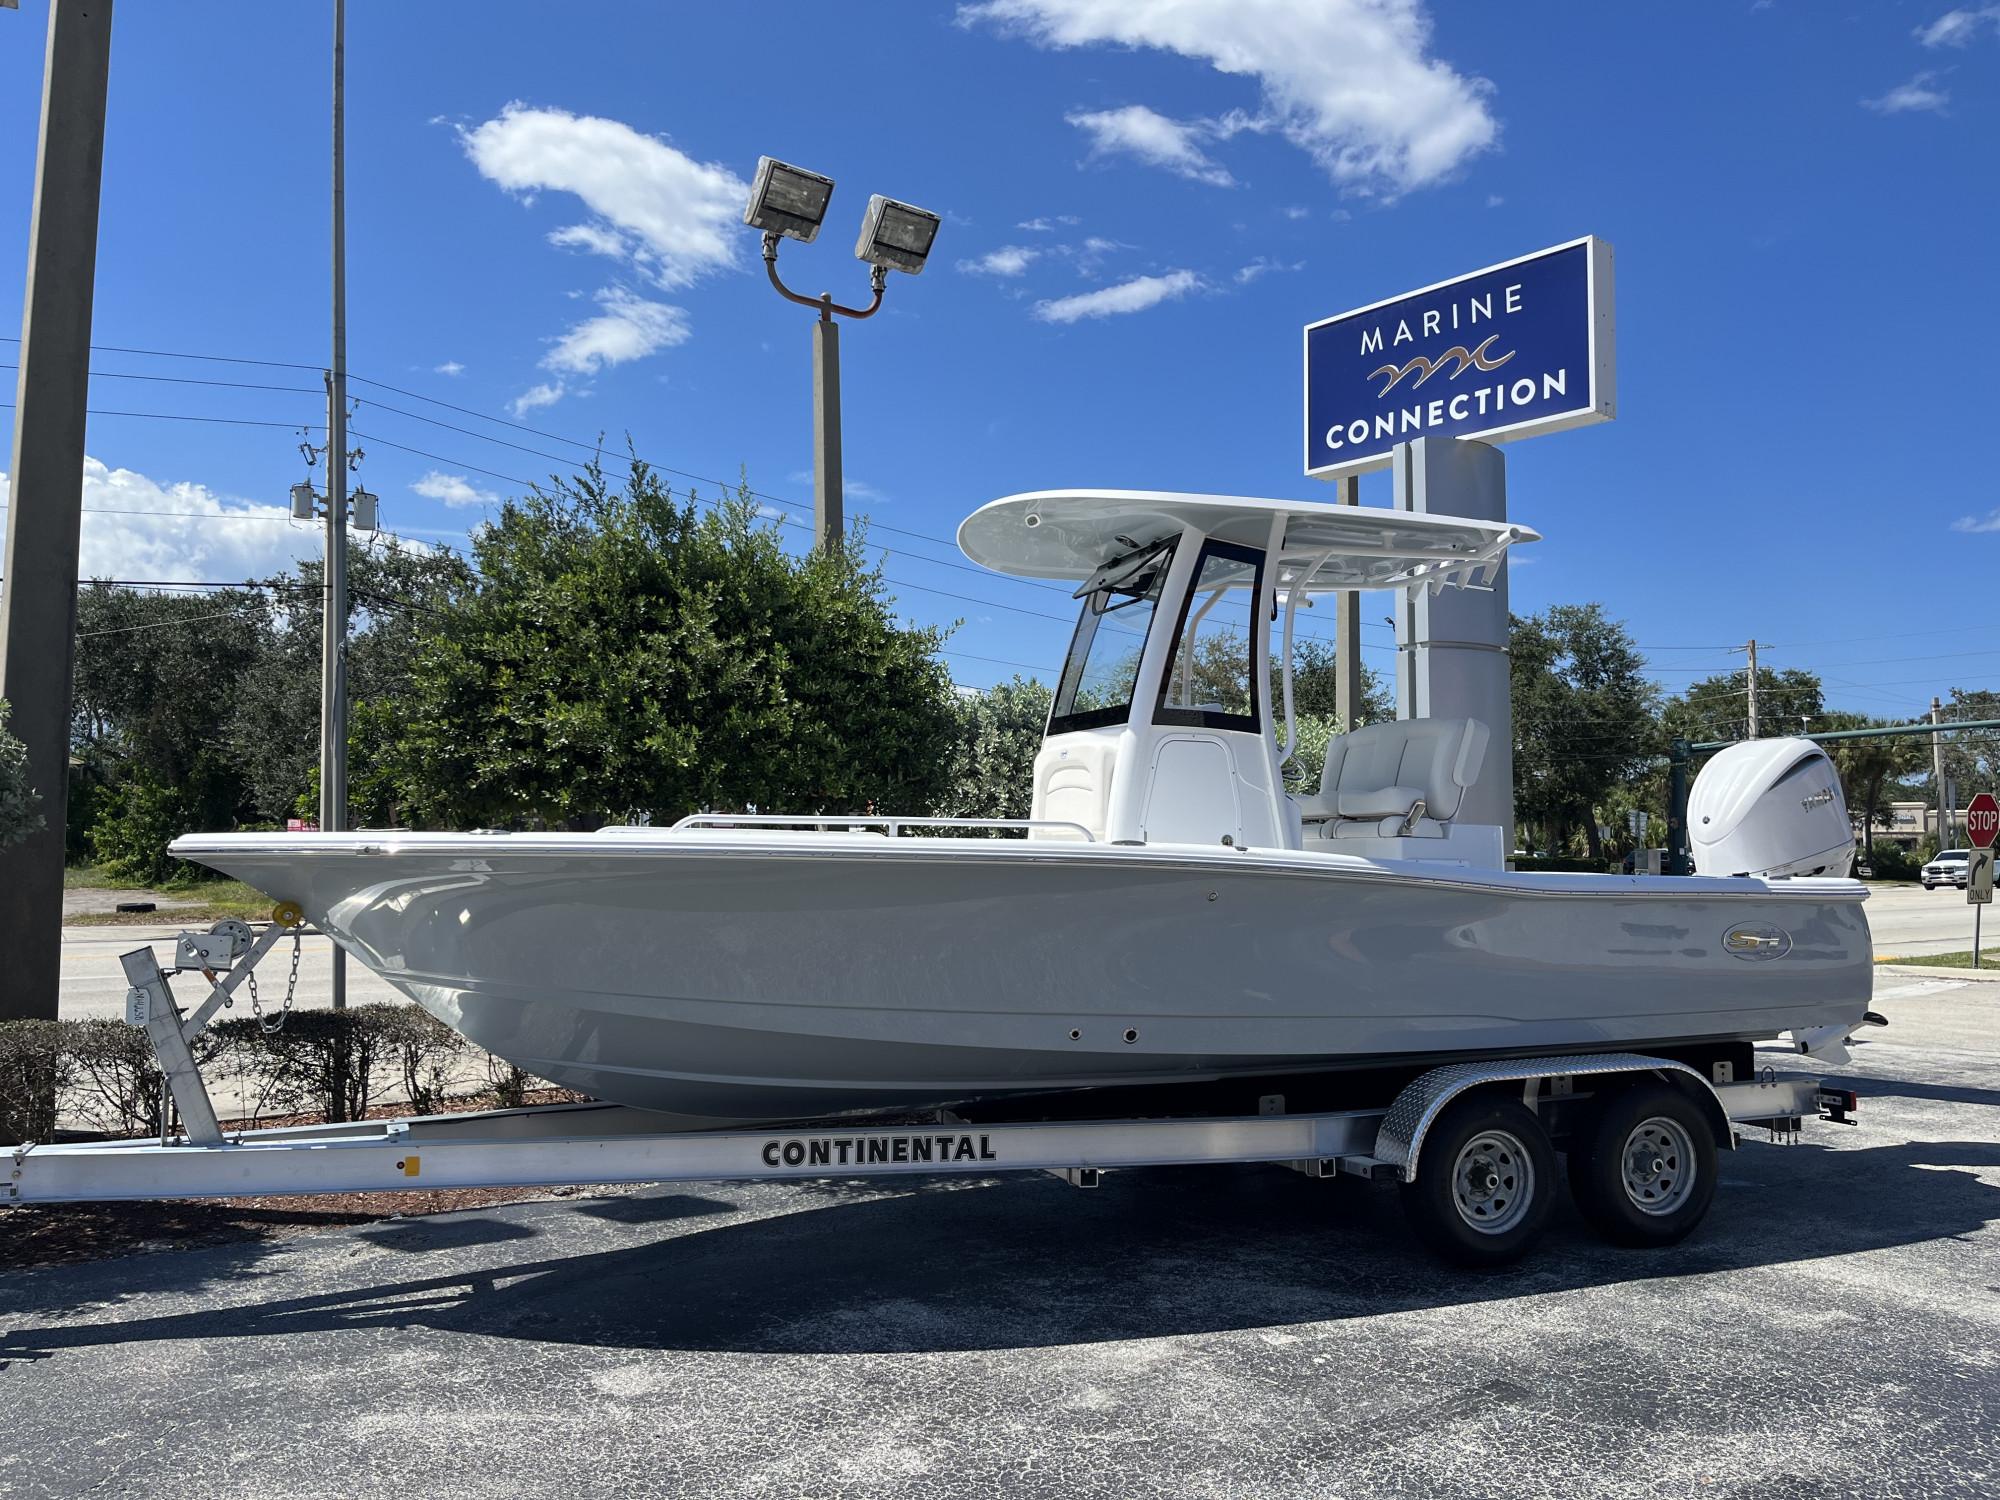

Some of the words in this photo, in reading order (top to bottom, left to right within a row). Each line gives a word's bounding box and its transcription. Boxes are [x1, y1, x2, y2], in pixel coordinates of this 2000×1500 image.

[1360, 284, 1523, 356] MARINE
[1325, 368, 1567, 449] CONNECTION
[1969, 810, 1998, 831] STOP
[1969, 888, 1990, 900] ONLY
[761, 1134, 997, 1168] CONTINENTAL
